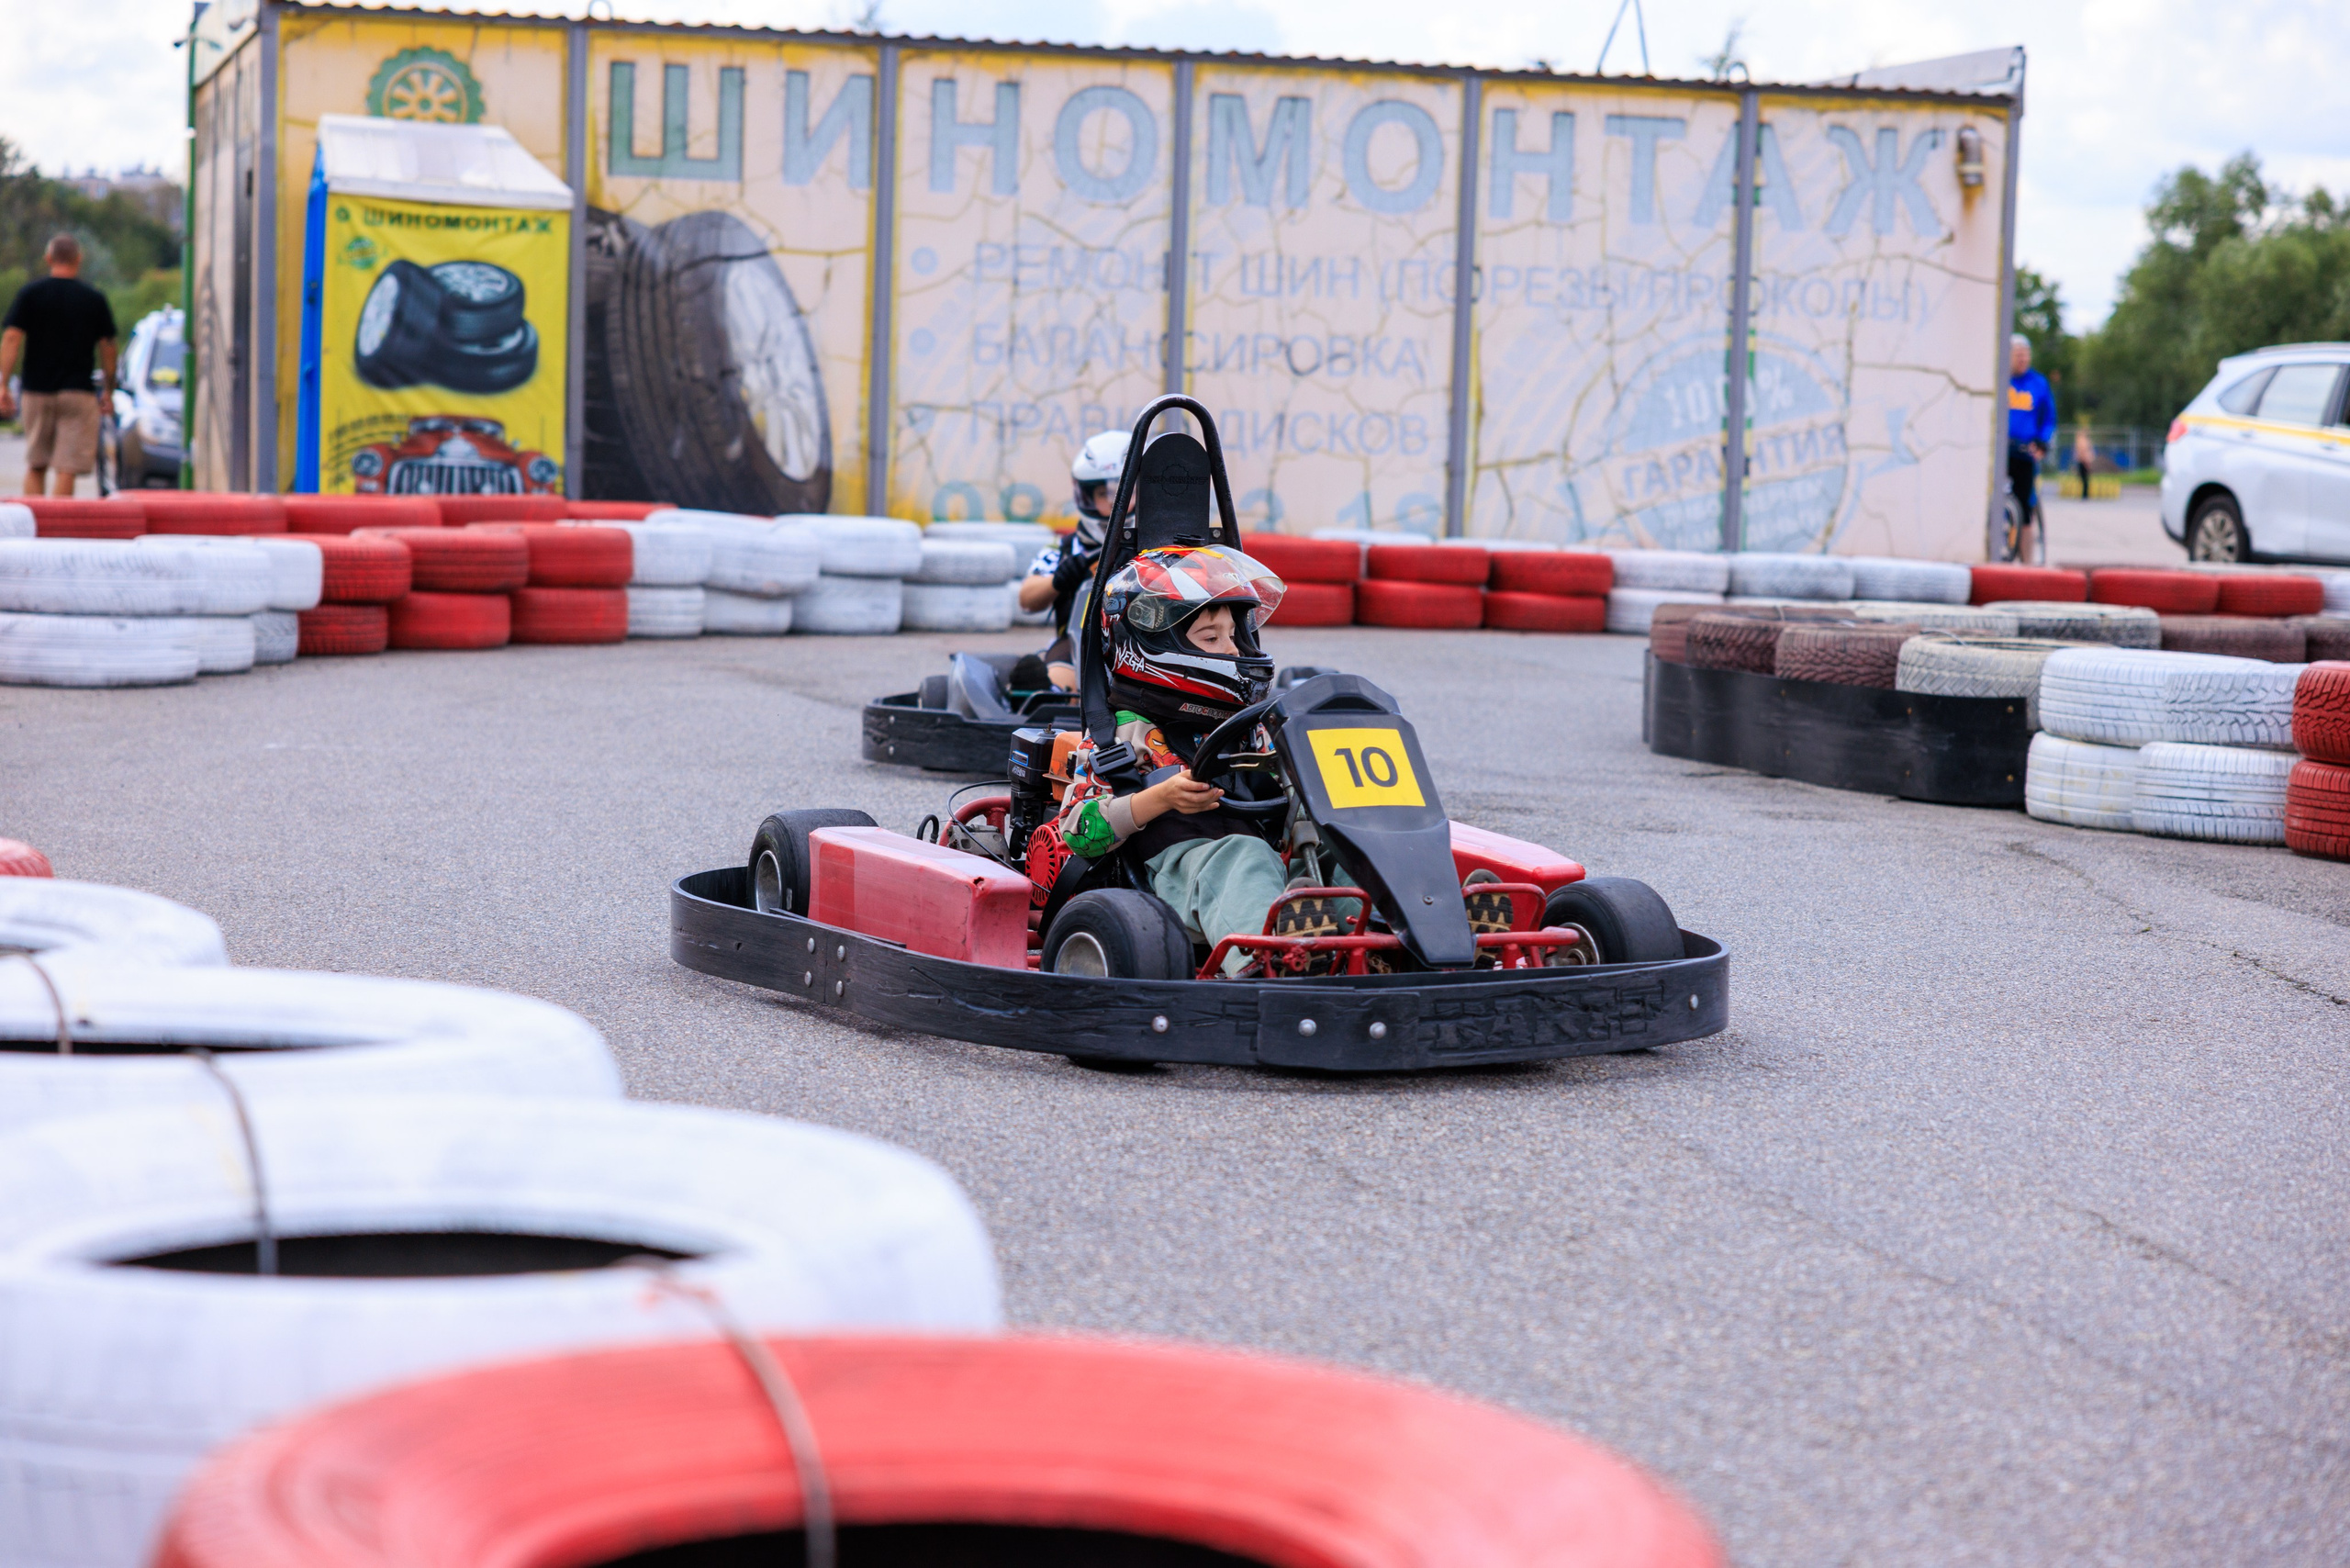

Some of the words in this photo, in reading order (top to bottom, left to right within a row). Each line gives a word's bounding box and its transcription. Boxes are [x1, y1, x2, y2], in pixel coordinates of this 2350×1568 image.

[607, 59, 1948, 236] ШИНОМОНТАЖ
[363, 207, 553, 234] ШИНОМОНТАЖ
[972, 241, 1225, 295] РЕМОНТ
[1240, 253, 1361, 299] ШИН
[973, 322, 1426, 382] БАЛАНСИРОВКА
[1220, 409, 1429, 458] ДИСКОВ
[1334, 746, 1398, 788] 10
